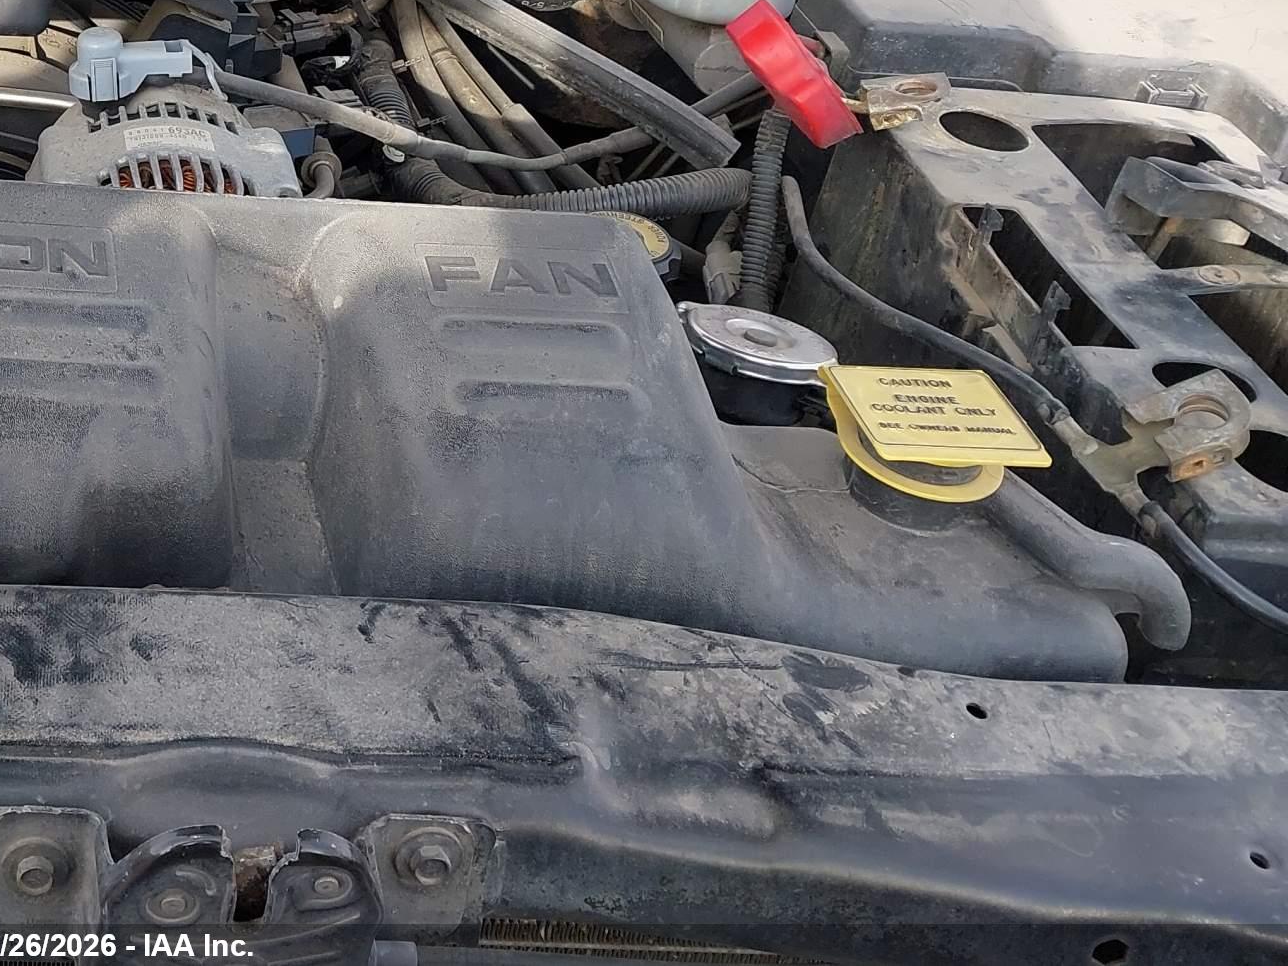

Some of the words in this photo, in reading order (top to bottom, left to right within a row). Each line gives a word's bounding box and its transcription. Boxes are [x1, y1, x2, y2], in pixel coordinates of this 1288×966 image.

[424, 255, 621, 298] FAN
[878, 377, 952, 388] CAUTION
[894, 394, 960, 405] ENGINE
[871, 403, 947, 415] COOLANT
[954, 407, 998, 416] ONLY
